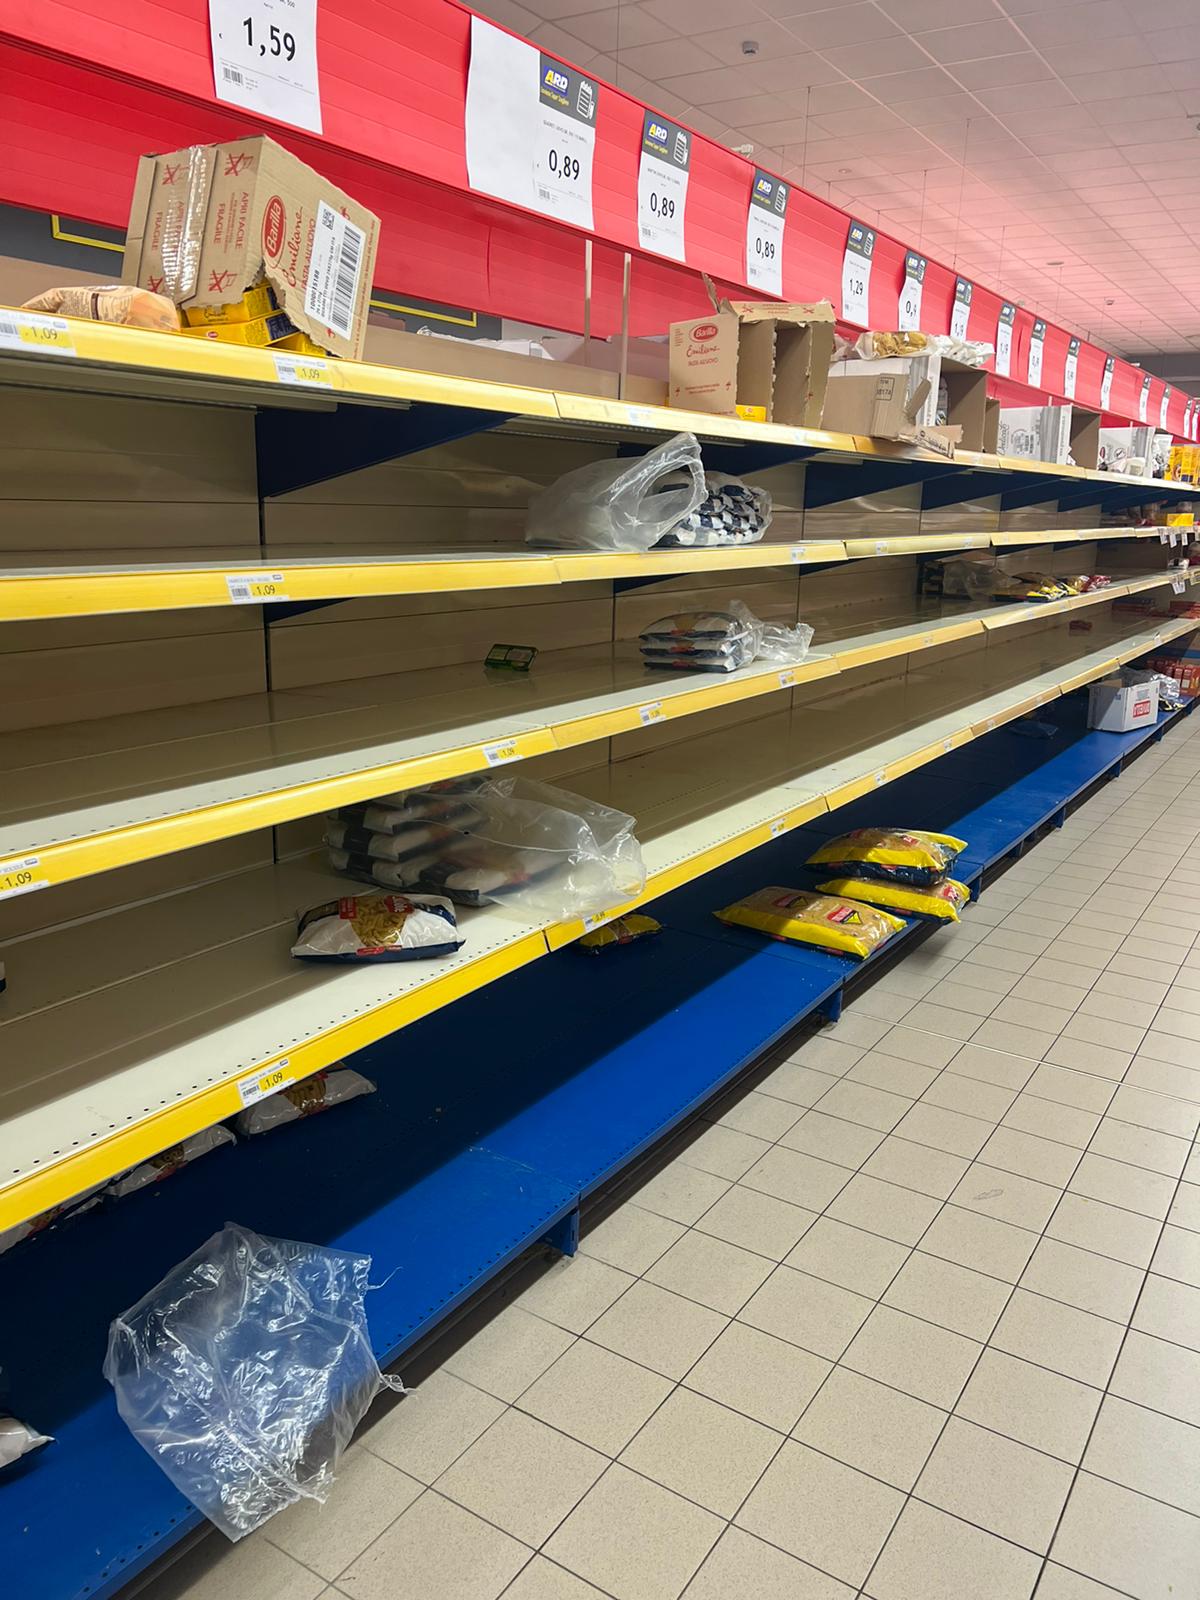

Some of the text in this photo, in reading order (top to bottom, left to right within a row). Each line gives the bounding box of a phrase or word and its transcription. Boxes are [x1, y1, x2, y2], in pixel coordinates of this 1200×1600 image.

[243, 17, 296, 61] 1,59
[545, 70, 568, 91] ARD
[649, 123, 667, 140] ARD
[549, 149, 580, 181] 0,89
[650, 192, 675, 219] 0,89
[151, 211, 163, 250] FRAGILE
[214, 203, 226, 245] FRAGILE
[235, 216, 248, 249] FACILE
[267, 202, 282, 254] Barilla
[282, 206, 303, 288] Emiliane
[756, 237, 775, 259] 0,89
[850, 278, 863, 296] 1,29
[32, 326, 57, 340] 1,09
[256, 585, 275, 596] 1,09
[5, 871, 32, 887] 1,09
[266, 1072, 283, 1087] 1,09
